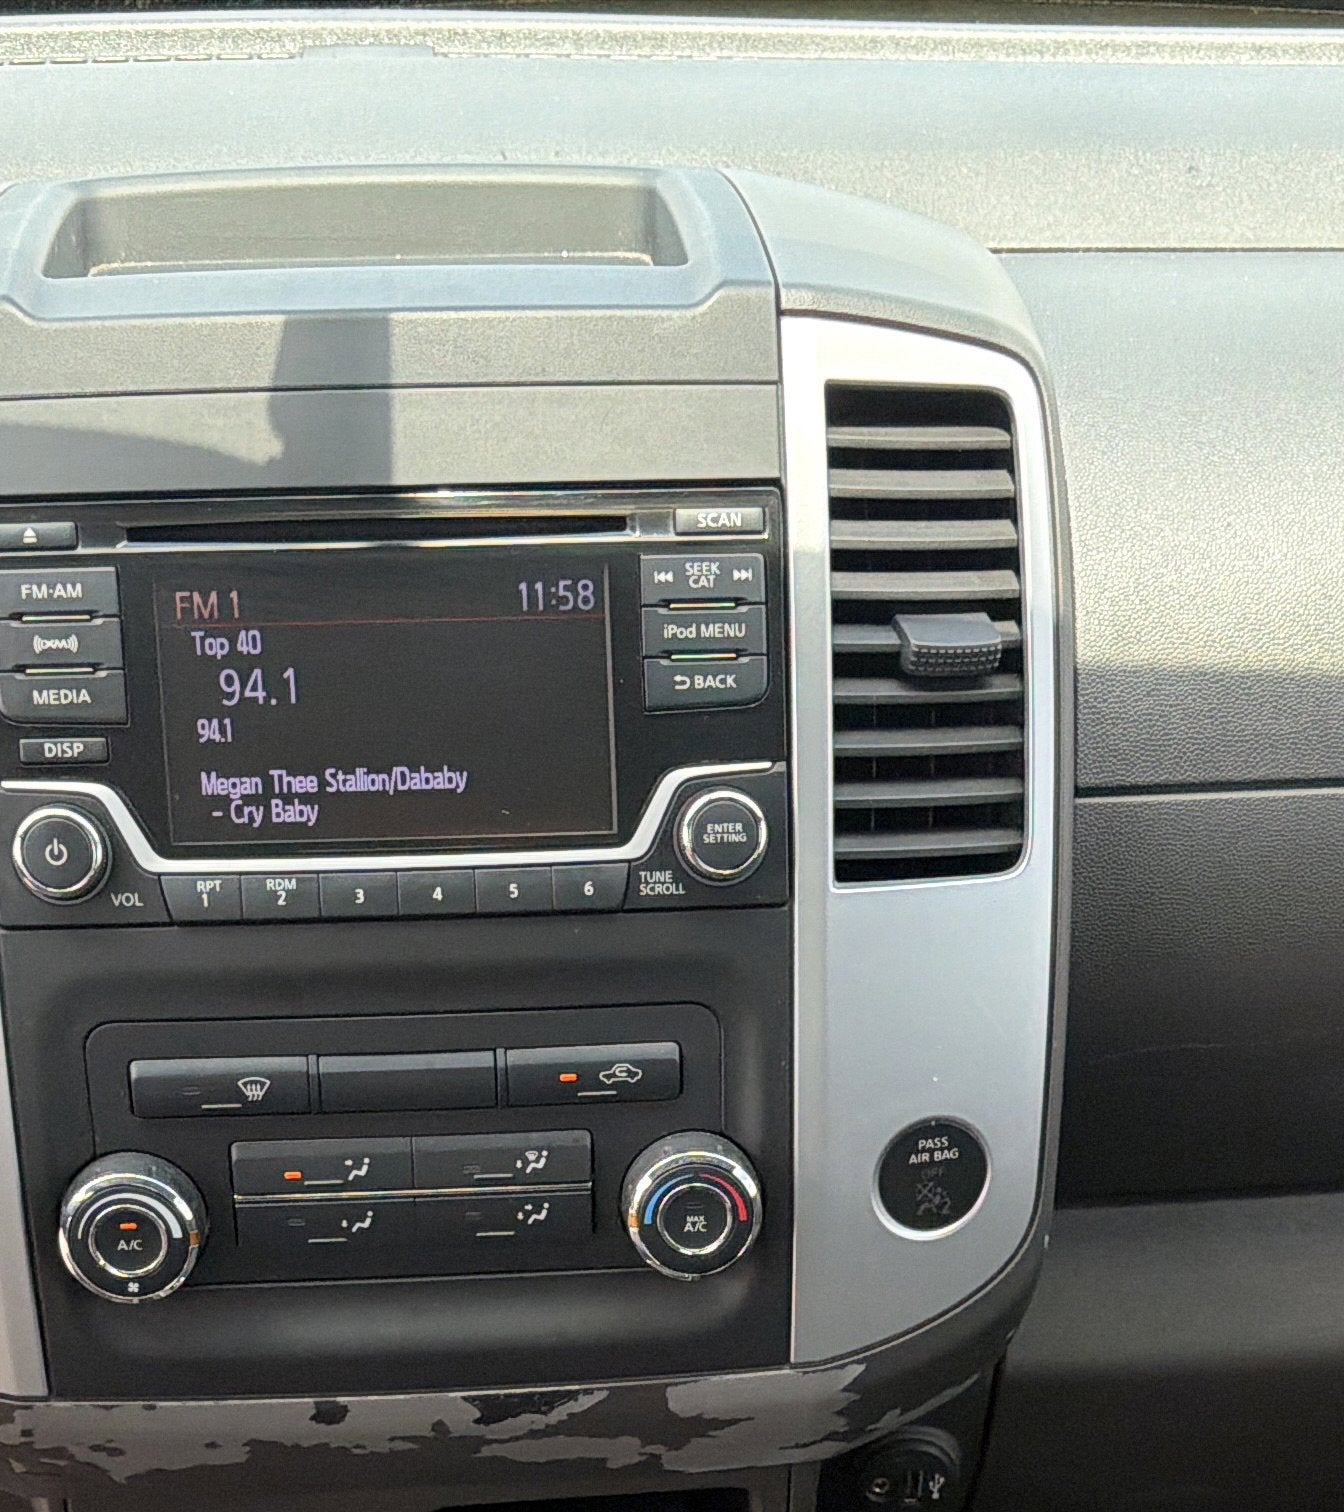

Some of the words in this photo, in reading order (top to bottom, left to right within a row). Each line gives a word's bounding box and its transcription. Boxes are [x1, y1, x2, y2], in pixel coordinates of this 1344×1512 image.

[696, 513, 742, 528] SCAN
[685, 562, 720, 576] SEEK
[688, 575, 716, 589] CAT
[518, 579, 596, 612] 11:58
[175, 591, 218, 620] FM
[229, 590, 240, 619] 1
[663, 623, 696, 640] iPod
[701, 623, 746, 639] MENU
[191, 631, 228, 660] Top
[237, 630, 262, 656] 40
[219, 667, 298, 707] 94.1
[694, 674, 737, 690] BACK
[33, 689, 92, 706] MEDIA
[197, 718, 233, 743] 94.1
[44, 743, 84, 758] DISP
[200, 772, 263, 798] Megan
[269, 770, 318, 794] Thee
[325, 766, 468, 796] Stallion/Dababy
[230, 800, 264, 827] Cry
[271, 799, 319, 826] Baby
[706, 823, 743, 834] ENTER
[702, 832, 747, 844] SETTING
[639, 870, 673, 884] TUNE
[196, 880, 222, 893] RPT
[266, 879, 297, 892] RDM
[509, 883, 519, 898] 5
[584, 882, 594, 897] 6
[639, 882, 686, 896] SCROLL
[110, 893, 144, 908] VOL
[201, 894, 210, 908] 1
[277, 892, 287, 906] 2
[355, 889, 365, 904] 3
[432, 887, 444, 901] 4
[918, 1136, 949, 1150] PASS
[908, 1152, 930, 1165] AIR
[933, 1148, 959, 1162] BAG
[684, 1221, 707, 1232] A/C
[117, 1239, 143, 1251] A/C
